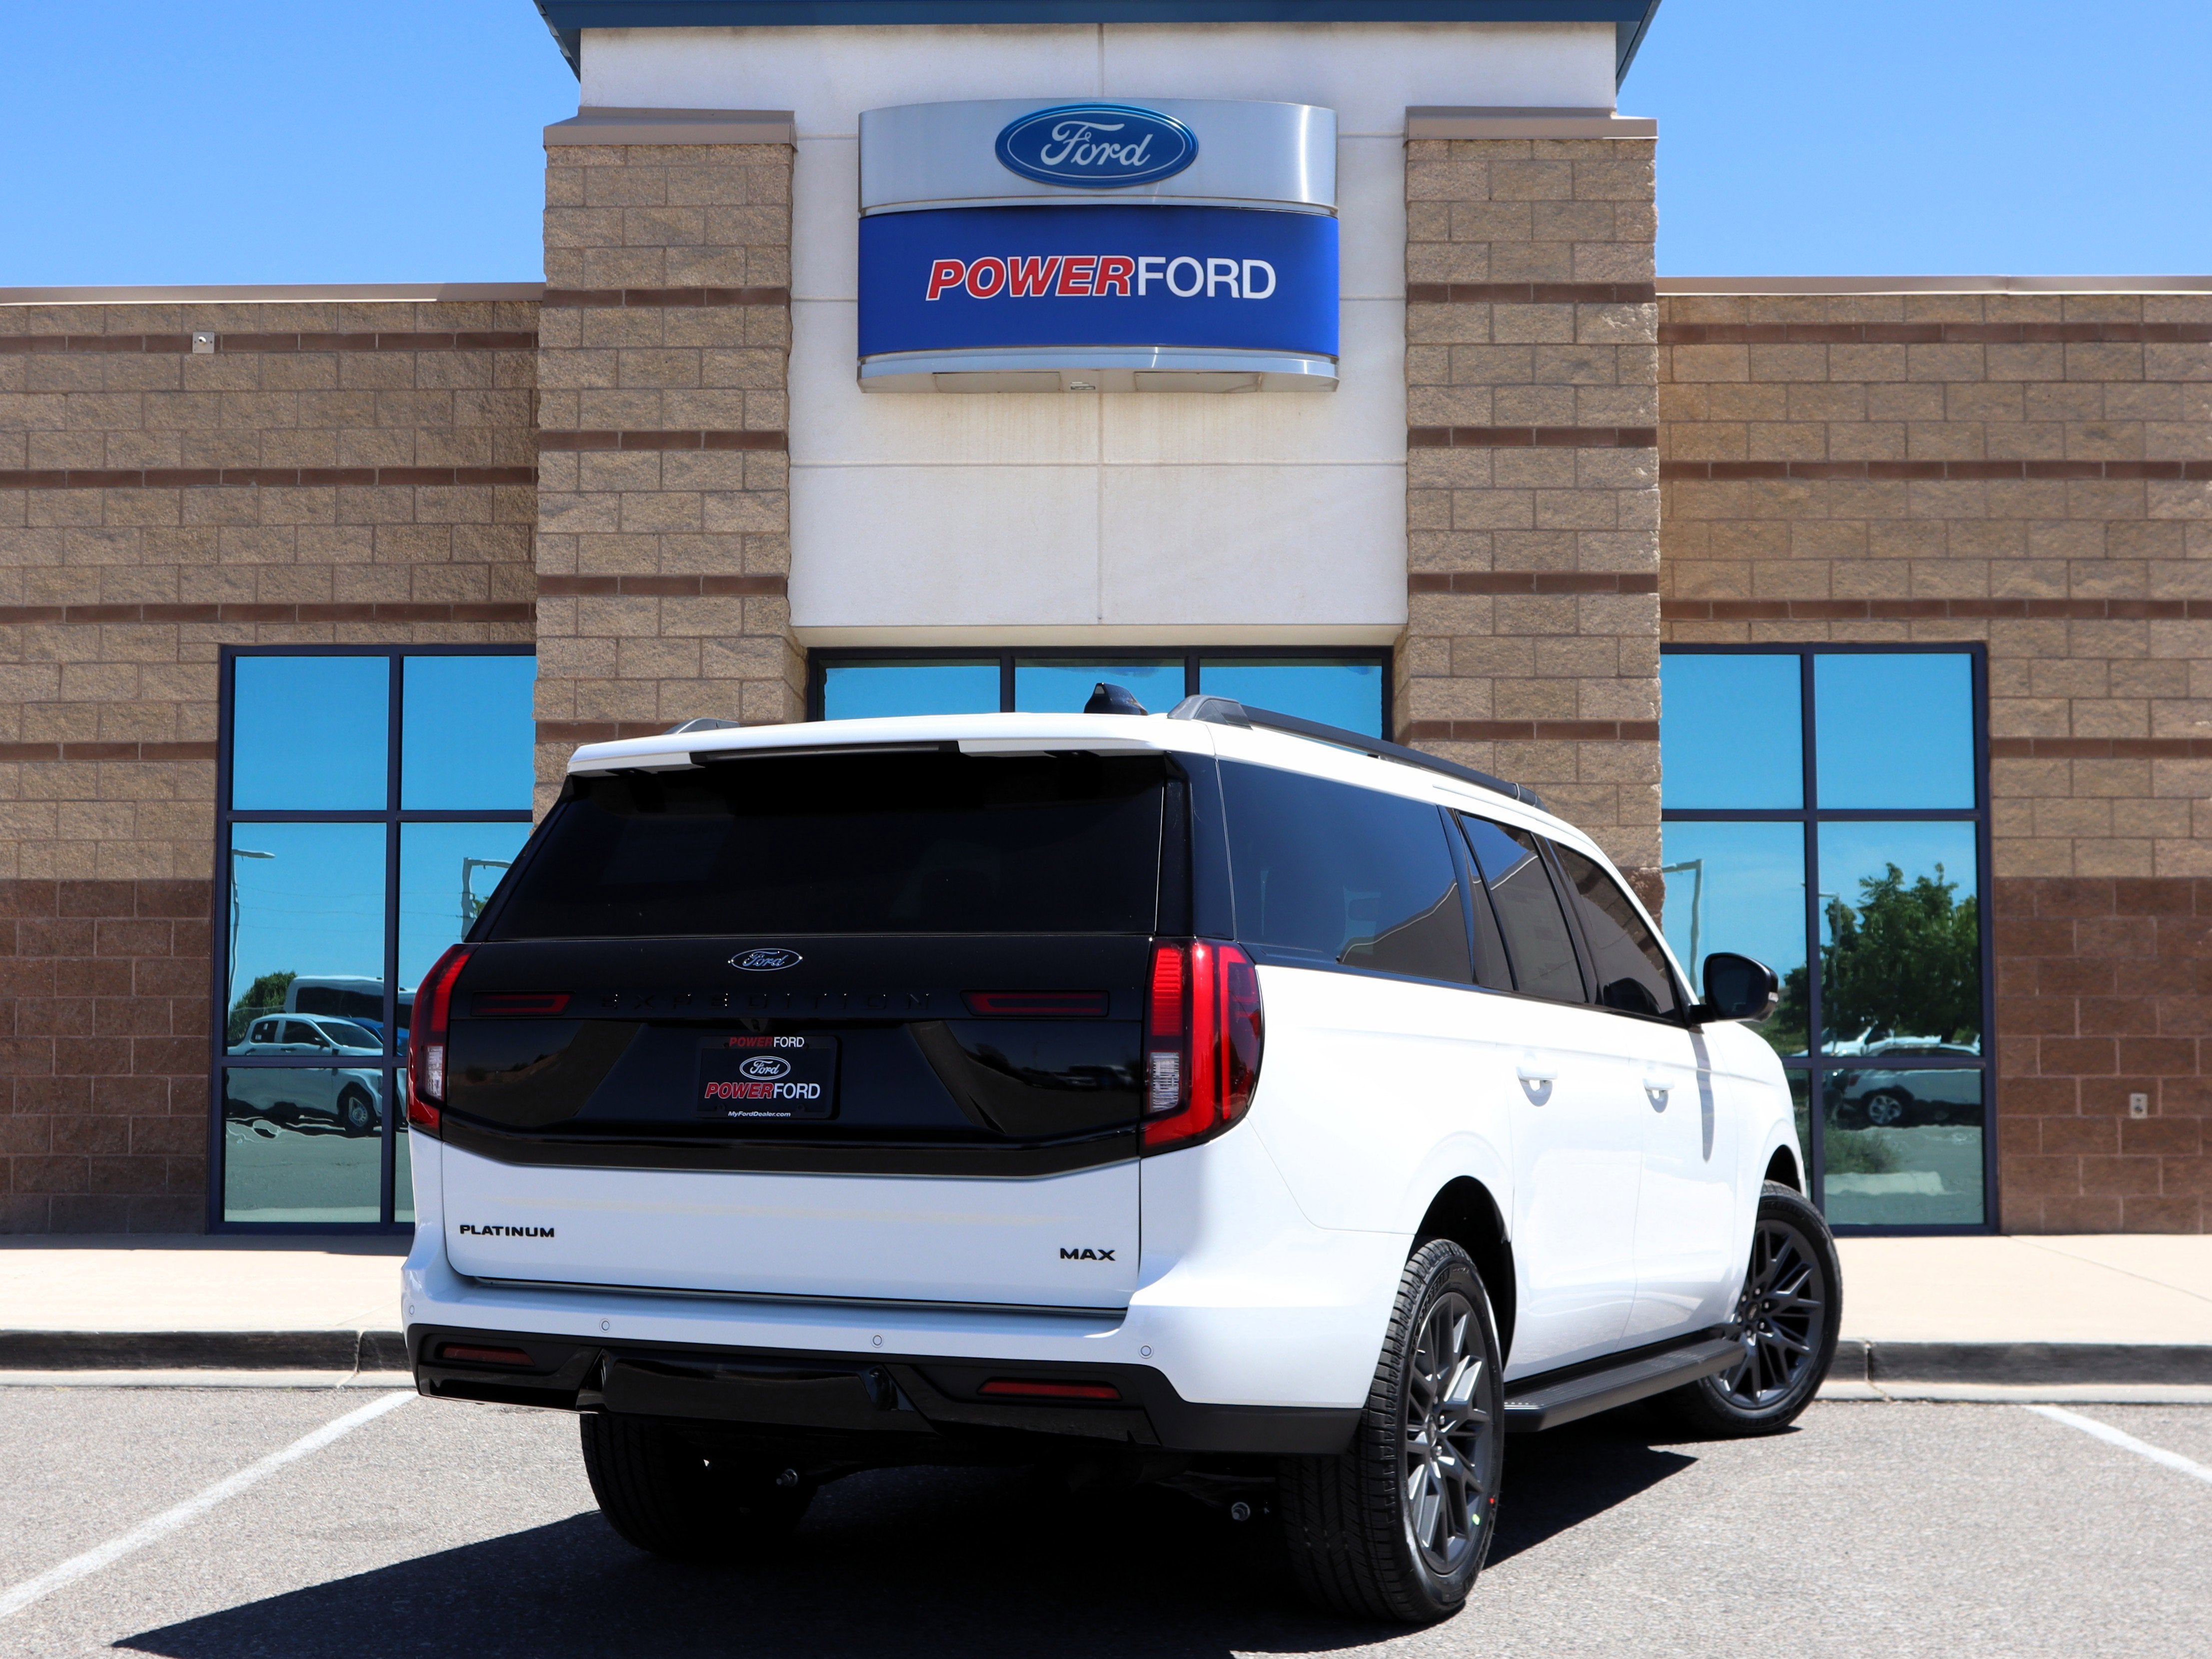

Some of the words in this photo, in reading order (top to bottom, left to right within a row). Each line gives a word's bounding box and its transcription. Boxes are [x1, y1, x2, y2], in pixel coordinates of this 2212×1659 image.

[1040, 120, 1153, 166] Ford
[925, 255, 1276, 301] POWERFORD
[742, 951, 789, 967] Ford
[728, 1036, 805, 1048] POWERFORD
[749, 1060, 780, 1074] Ford
[704, 1082, 820, 1099] POWERFORD
[459, 1225, 554, 1238] PLATINUM
[1060, 1248, 1116, 1261] MAX
